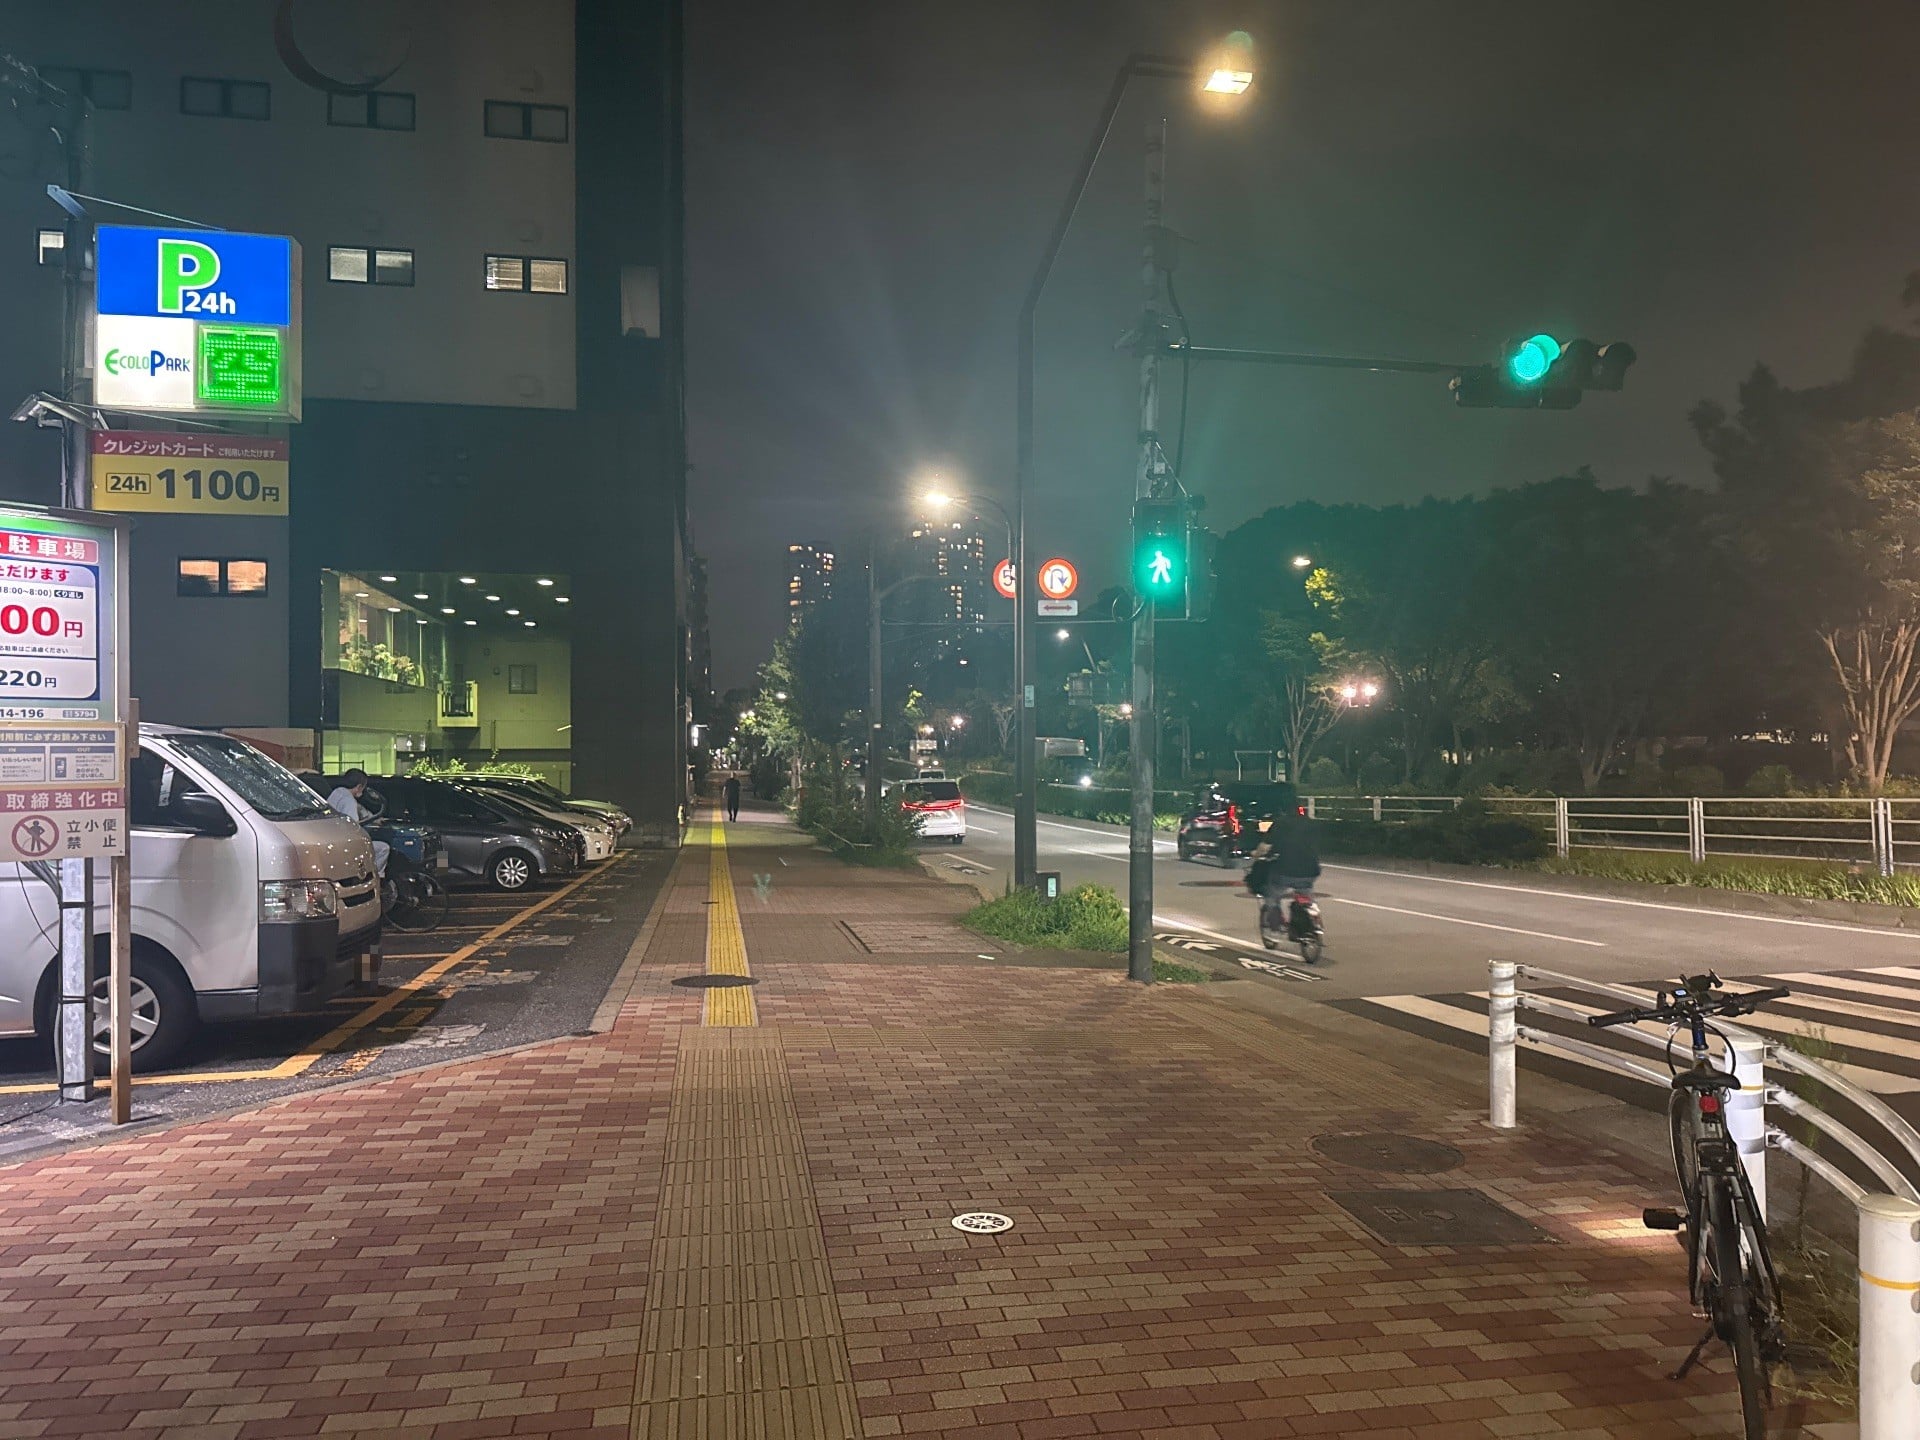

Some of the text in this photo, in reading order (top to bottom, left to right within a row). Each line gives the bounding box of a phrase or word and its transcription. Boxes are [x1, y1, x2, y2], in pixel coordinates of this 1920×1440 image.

[158, 239, 220, 313] P
[185, 292, 236, 314] 24h
[104, 439, 214, 457] クレジットカード
[110, 469, 279, 502] 24h 1100円
[0, 535, 85, 560] 駐車場
[6, 790, 118, 811] 取締強化中
[67, 819, 117, 834] 立小便
